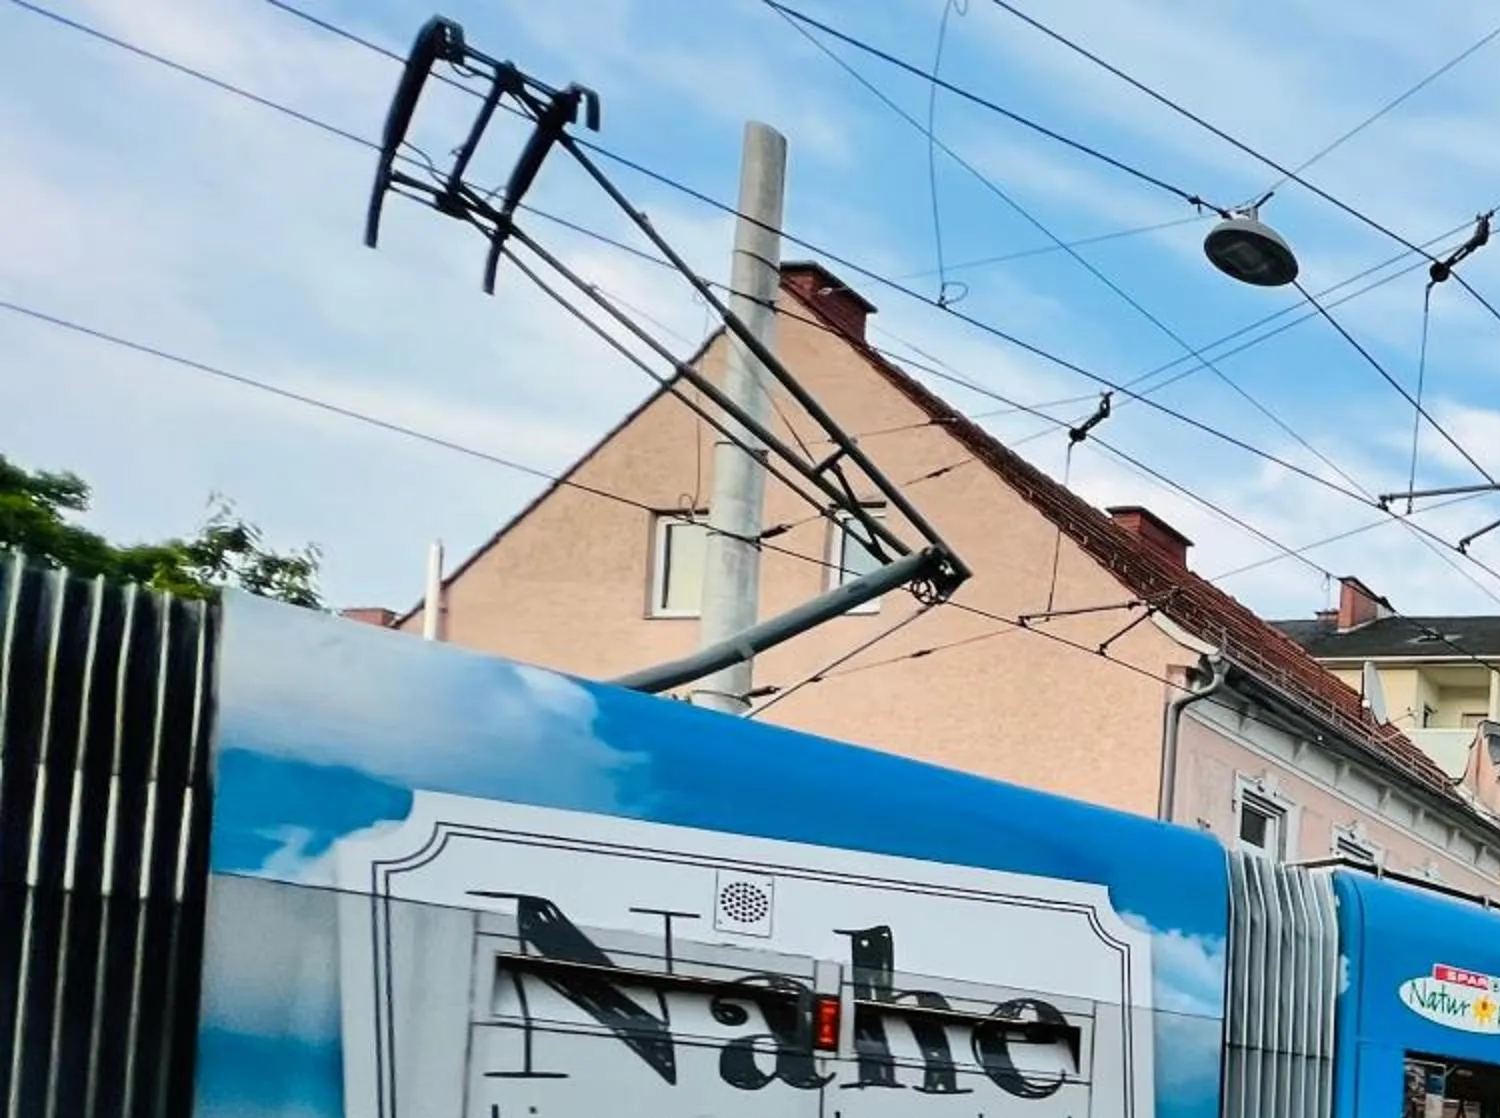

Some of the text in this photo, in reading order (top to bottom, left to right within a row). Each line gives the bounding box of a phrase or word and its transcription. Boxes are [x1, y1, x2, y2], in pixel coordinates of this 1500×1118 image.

[465, 890, 1071, 1100] Nahe
[1446, 969, 1489, 990] SPAR
[1408, 981, 1471, 1017] Natur
